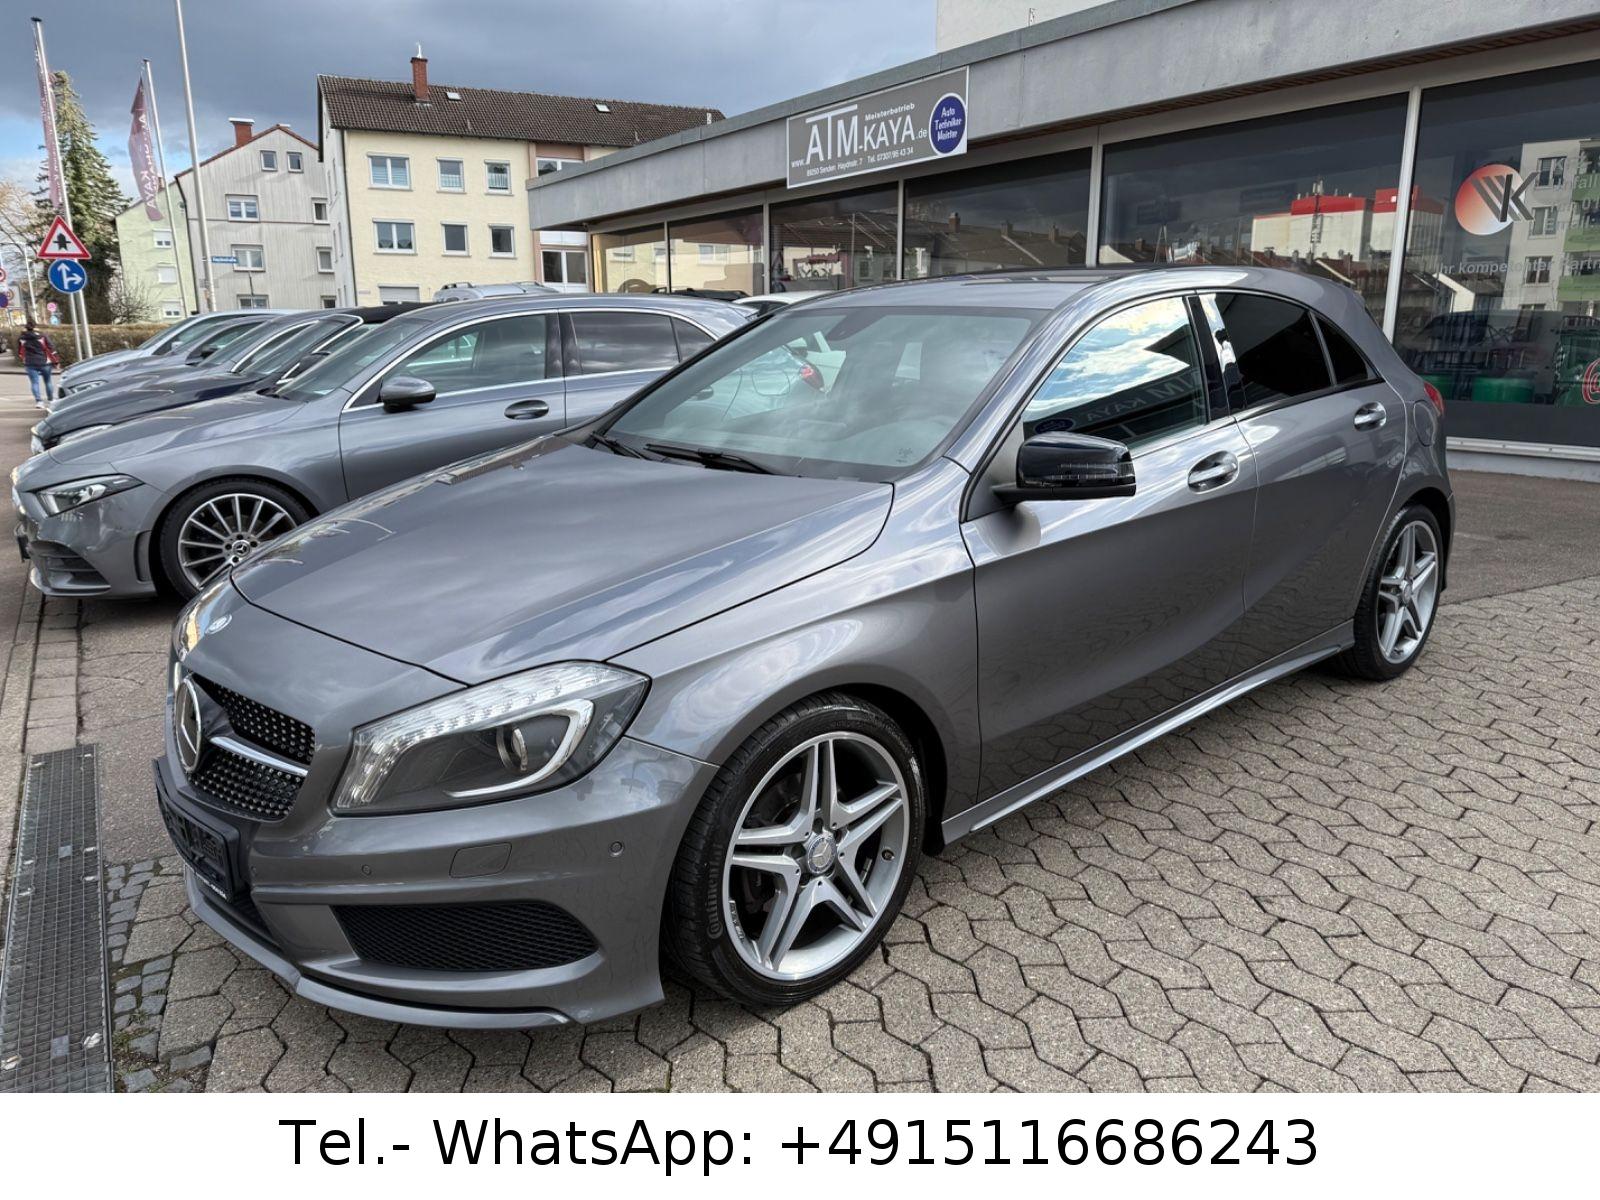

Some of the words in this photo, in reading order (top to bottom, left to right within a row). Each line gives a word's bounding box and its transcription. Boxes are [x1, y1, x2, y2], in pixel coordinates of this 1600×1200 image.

[864, 102, 915, 122] Meisterbetrieb
[941, 106, 956, 118] Auto
[934, 116, 962, 131] Techniker
[937, 130, 958, 142] Meister
